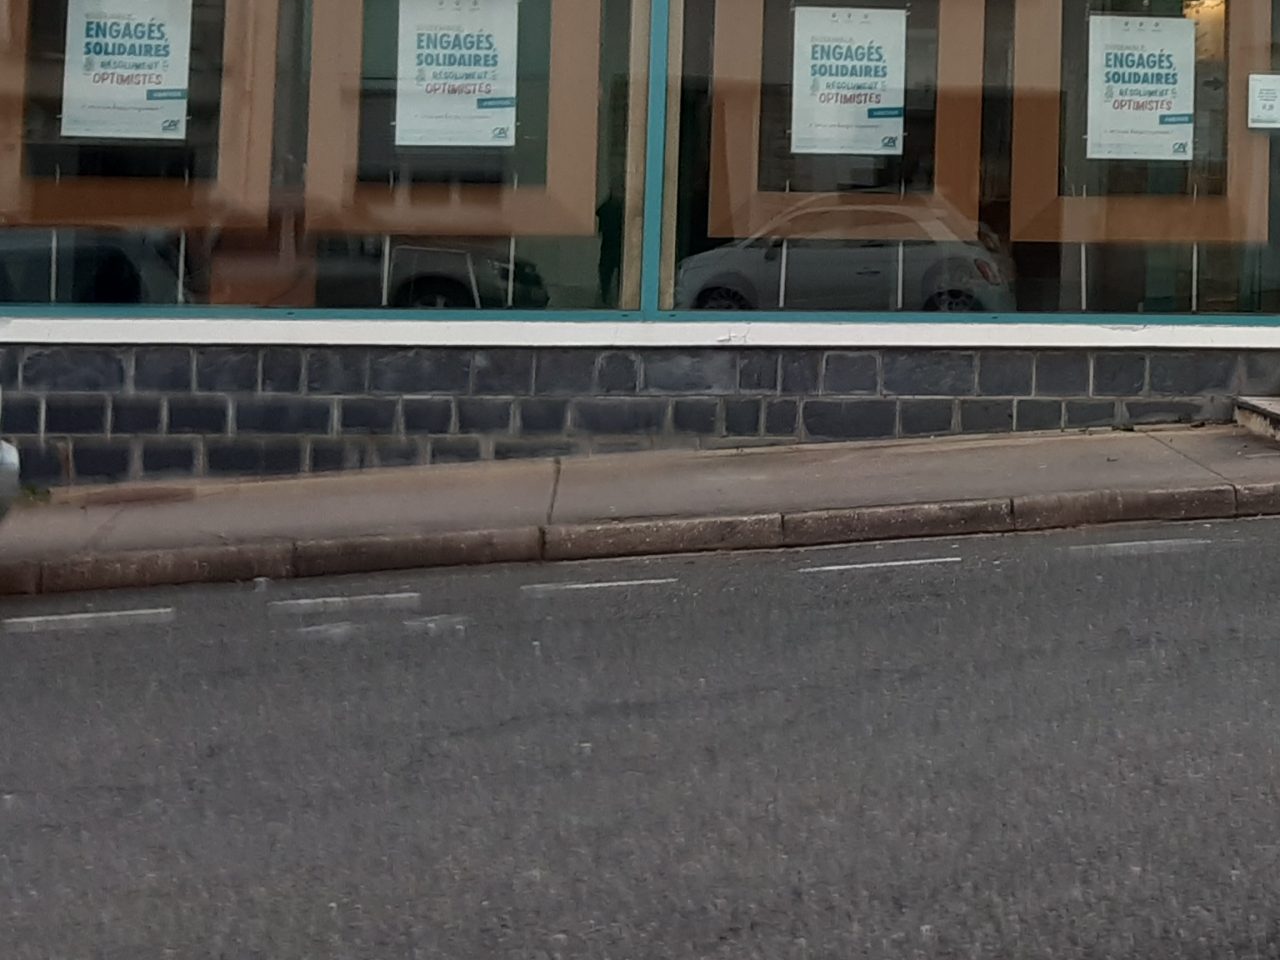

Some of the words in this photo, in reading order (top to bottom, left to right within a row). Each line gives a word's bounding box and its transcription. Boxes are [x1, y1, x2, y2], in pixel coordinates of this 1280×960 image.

[84, 42, 170, 57] SOLIDAIRES
[416, 52, 499, 67] SOLIDAIRES
[810, 64, 888, 78] SOLIDAIRES
[92, 72, 162, 85] OPTIMISTES
[1104, 71, 1178, 85] SOLIDAIRES
[425, 82, 492, 95] OPTIMISTES
[819, 92, 882, 105] OPTIMISTES
[1112, 99, 1173, 111] OPTIMISTES
